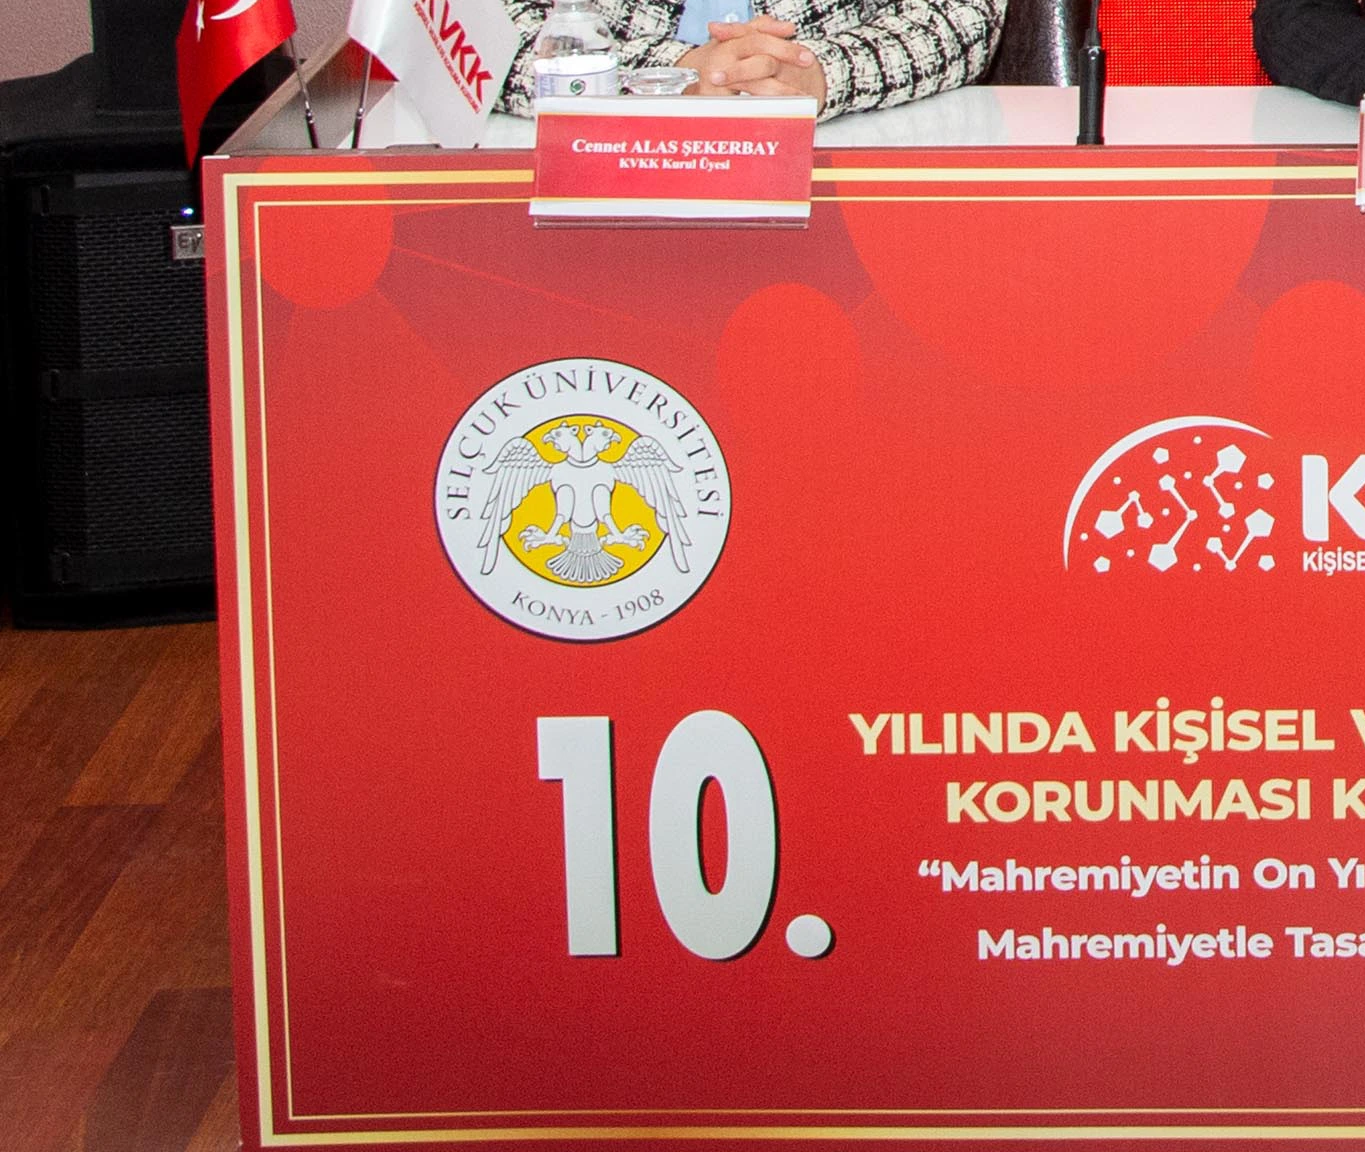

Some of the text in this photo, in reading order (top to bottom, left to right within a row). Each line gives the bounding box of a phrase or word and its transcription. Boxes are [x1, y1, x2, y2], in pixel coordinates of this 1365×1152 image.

[572, 139, 779, 156] Cennet ALAS ŞEKERBAY
[619, 157, 730, 172] KVKK Kurul Üyesi
[446, 365, 724, 521] SELÇUK ÜNİVERSİTESİ
[511, 589, 595, 627] KONYA
[615, 588, 666, 623] 1908
[849, 712, 1096, 754] YILINDA
[1115, 697, 1335, 764] KİŞİSEL
[947, 779, 1310, 822] KORUNMASI
[535, 711, 836, 961] 10.
[1254, 858, 1315, 889] On
[978, 924, 1273, 965] Mahremiyetle
